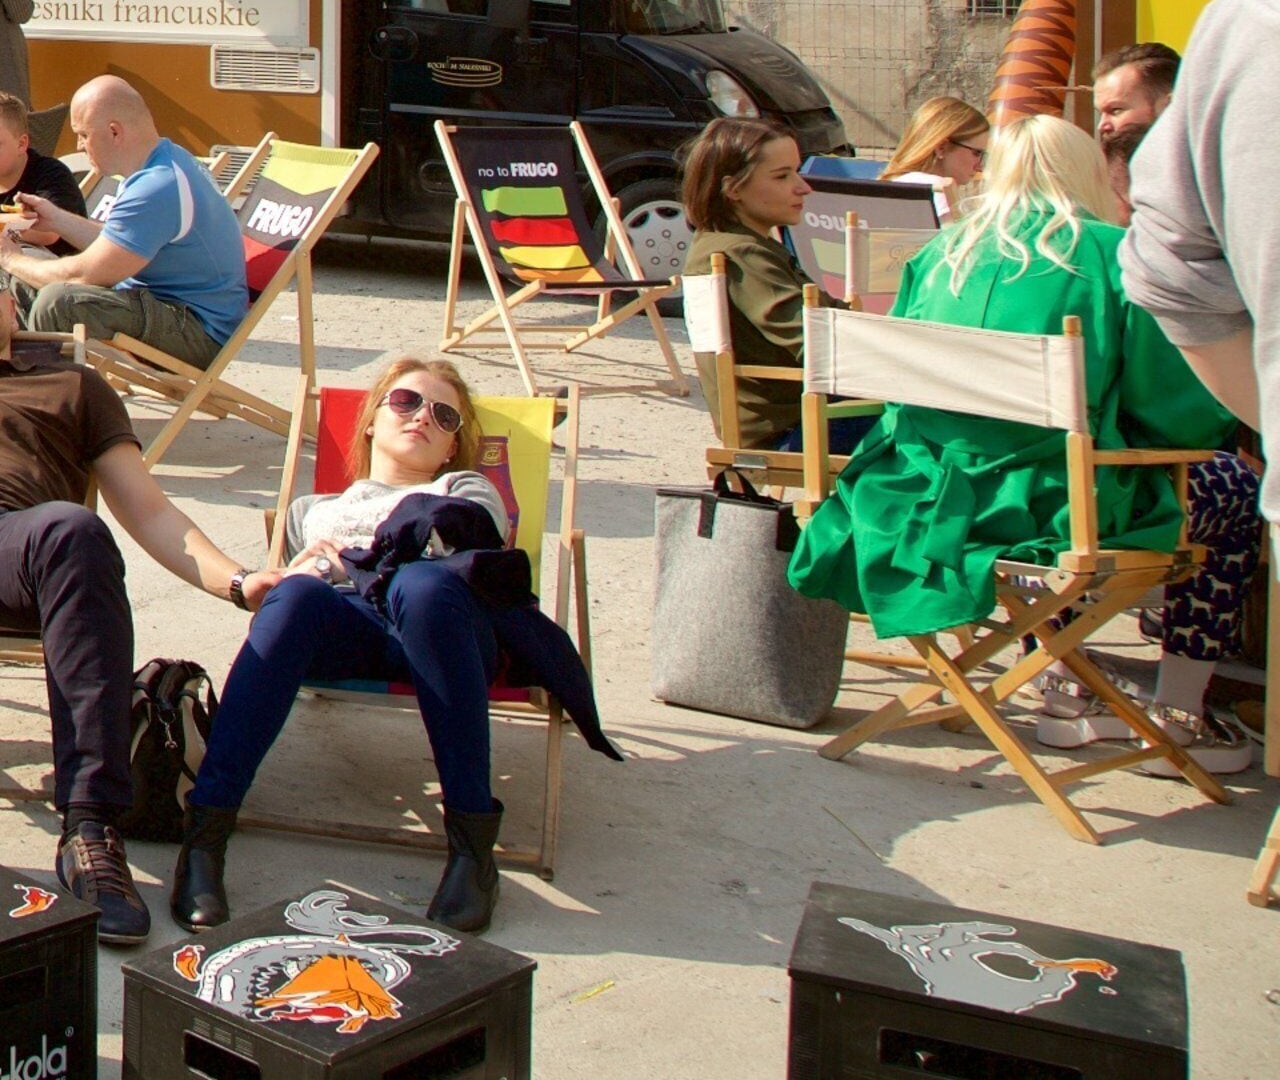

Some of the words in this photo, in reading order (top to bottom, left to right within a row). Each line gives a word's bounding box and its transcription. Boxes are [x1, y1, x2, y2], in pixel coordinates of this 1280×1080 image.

[478, 168, 494, 177] no
[496, 166, 509, 177] to
[510, 162, 558, 177] FRUGO
[247, 198, 314, 237] FRUGO
